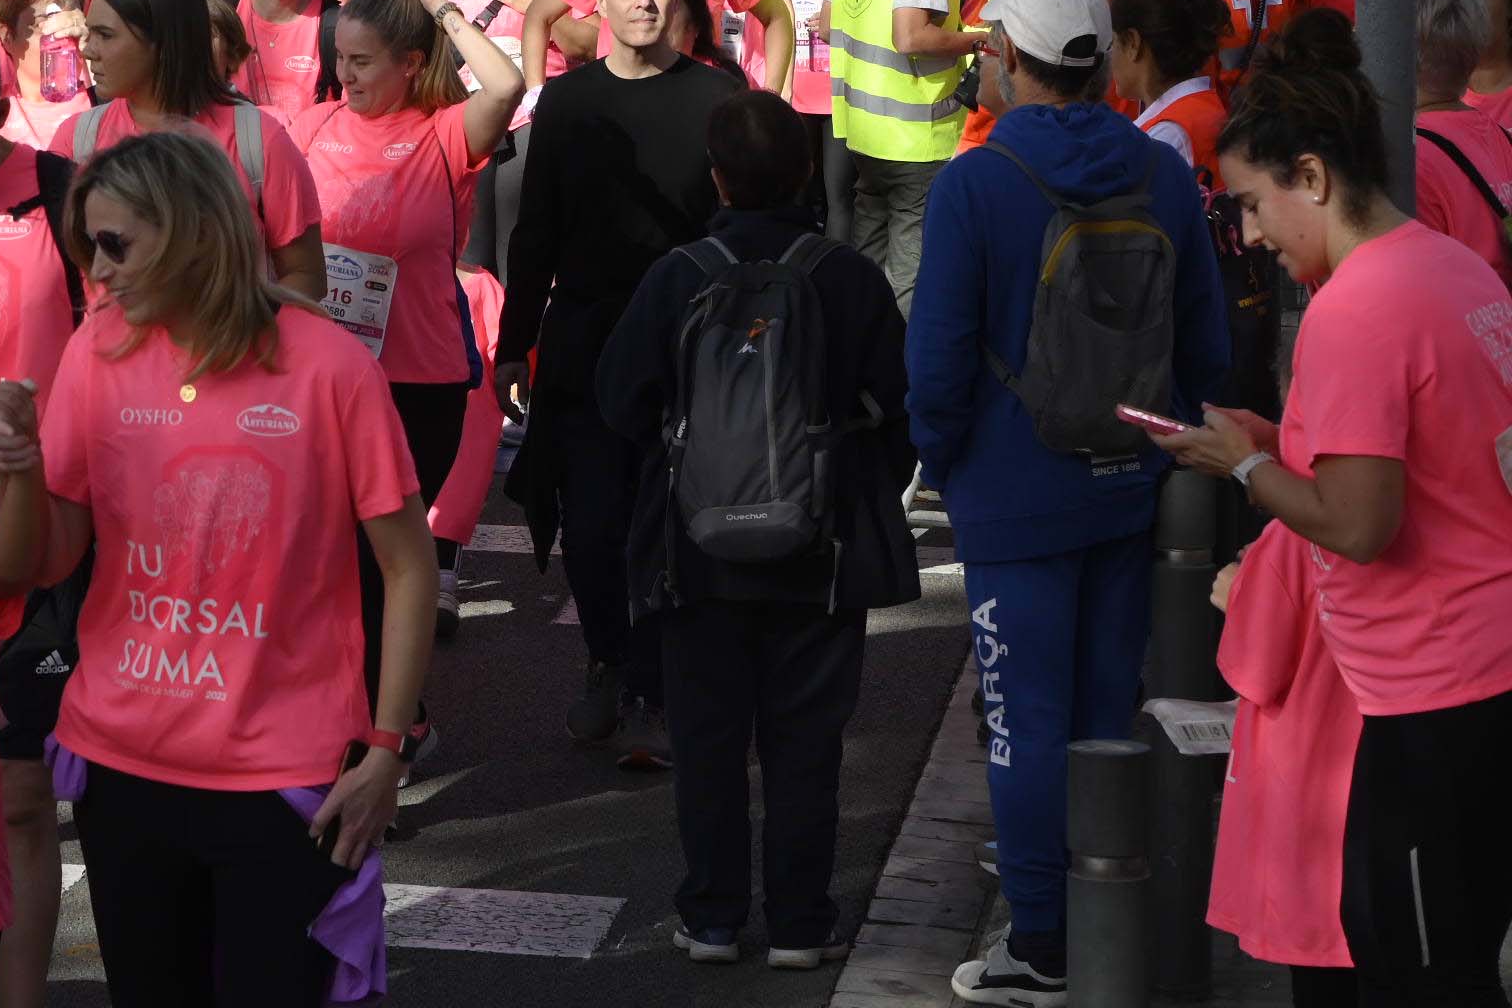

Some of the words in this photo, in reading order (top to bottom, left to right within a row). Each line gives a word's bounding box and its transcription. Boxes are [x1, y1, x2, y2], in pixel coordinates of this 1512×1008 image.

[330, 287, 353, 304] 16
[120, 407, 183, 427] OYSHO
[241, 413, 296, 431] ASTURIANA
[1092, 466, 1119, 477] SINCE
[725, 512, 768, 522] Quechua
[130, 590, 269, 639] DORSAL
[36, 664, 70, 674] adidas
[117, 638, 225, 688] SUMA
[971, 597, 1013, 768] BARÇA
